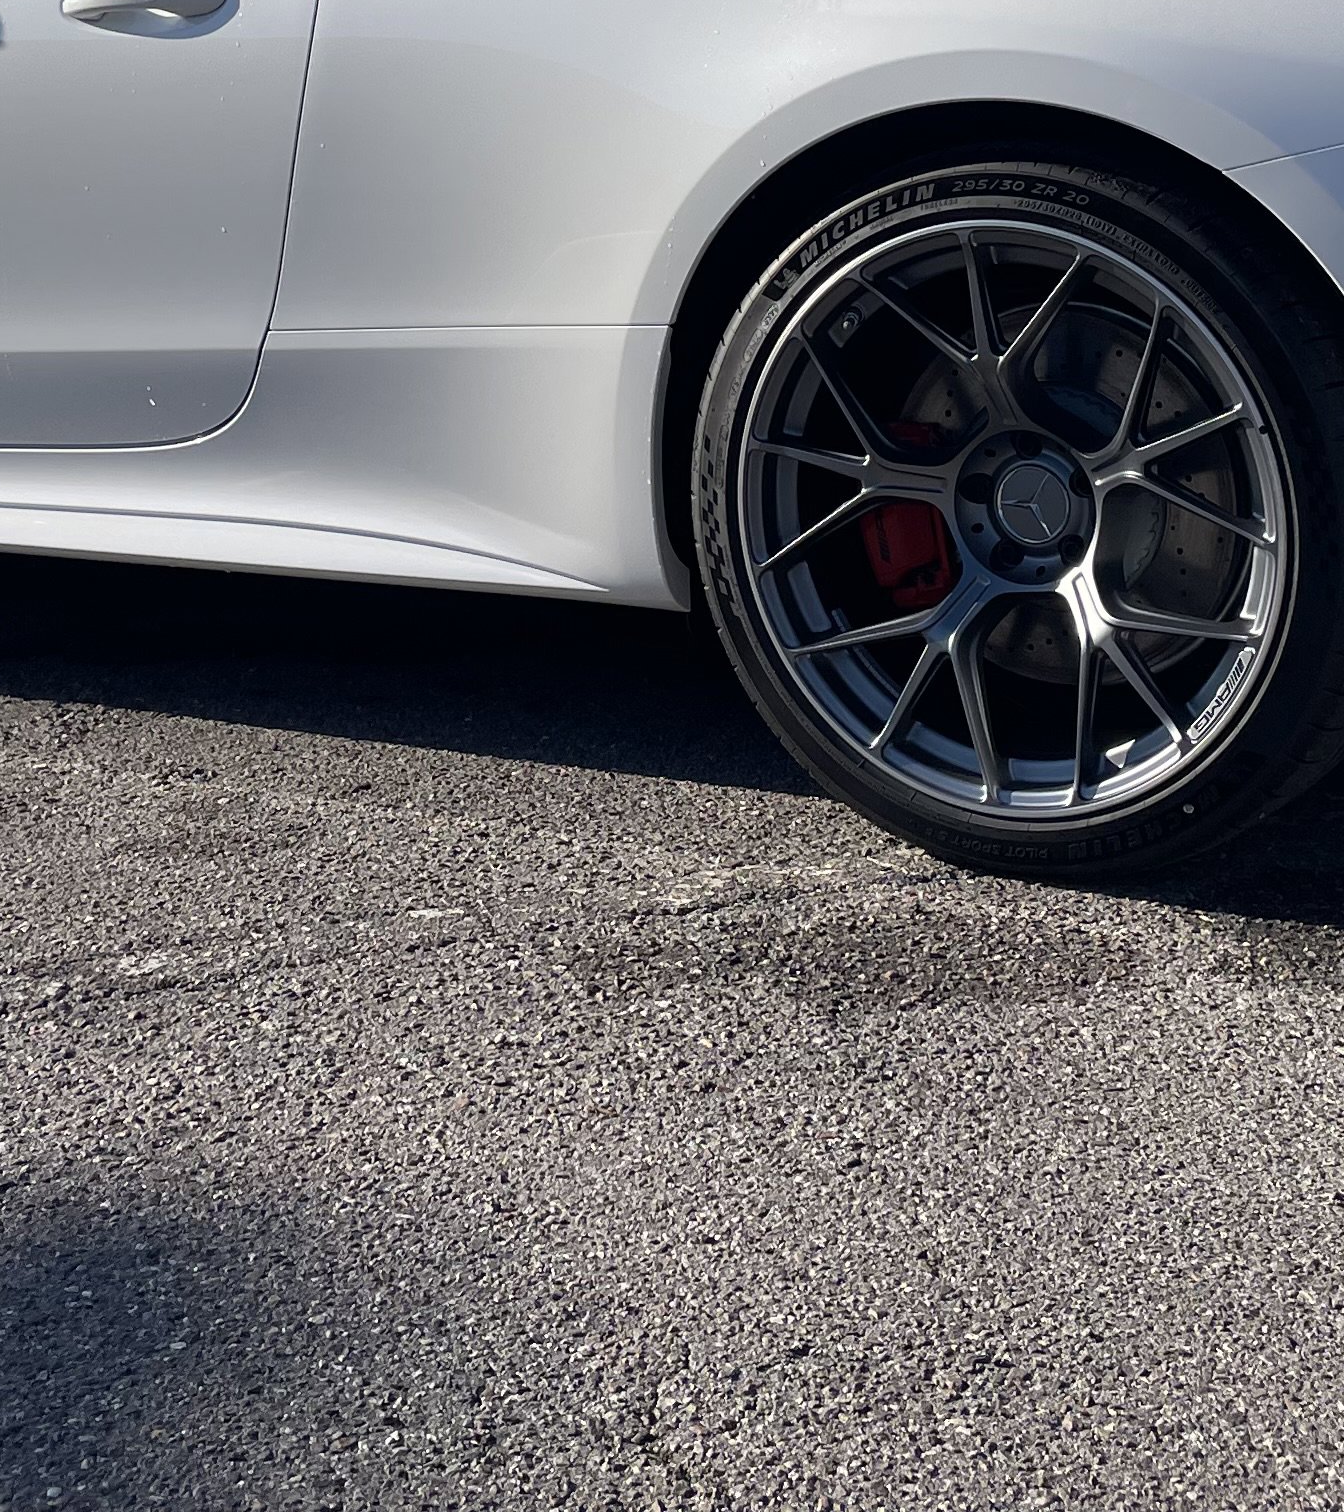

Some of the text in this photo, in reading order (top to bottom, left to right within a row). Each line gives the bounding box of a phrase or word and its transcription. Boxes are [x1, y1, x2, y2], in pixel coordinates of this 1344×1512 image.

[800, 182, 935, 268] MICHELIN
[952, 179, 1025, 192] 295/30
[1031, 182, 1058, 197] ZR
[1062, 190, 1090, 205] 20
